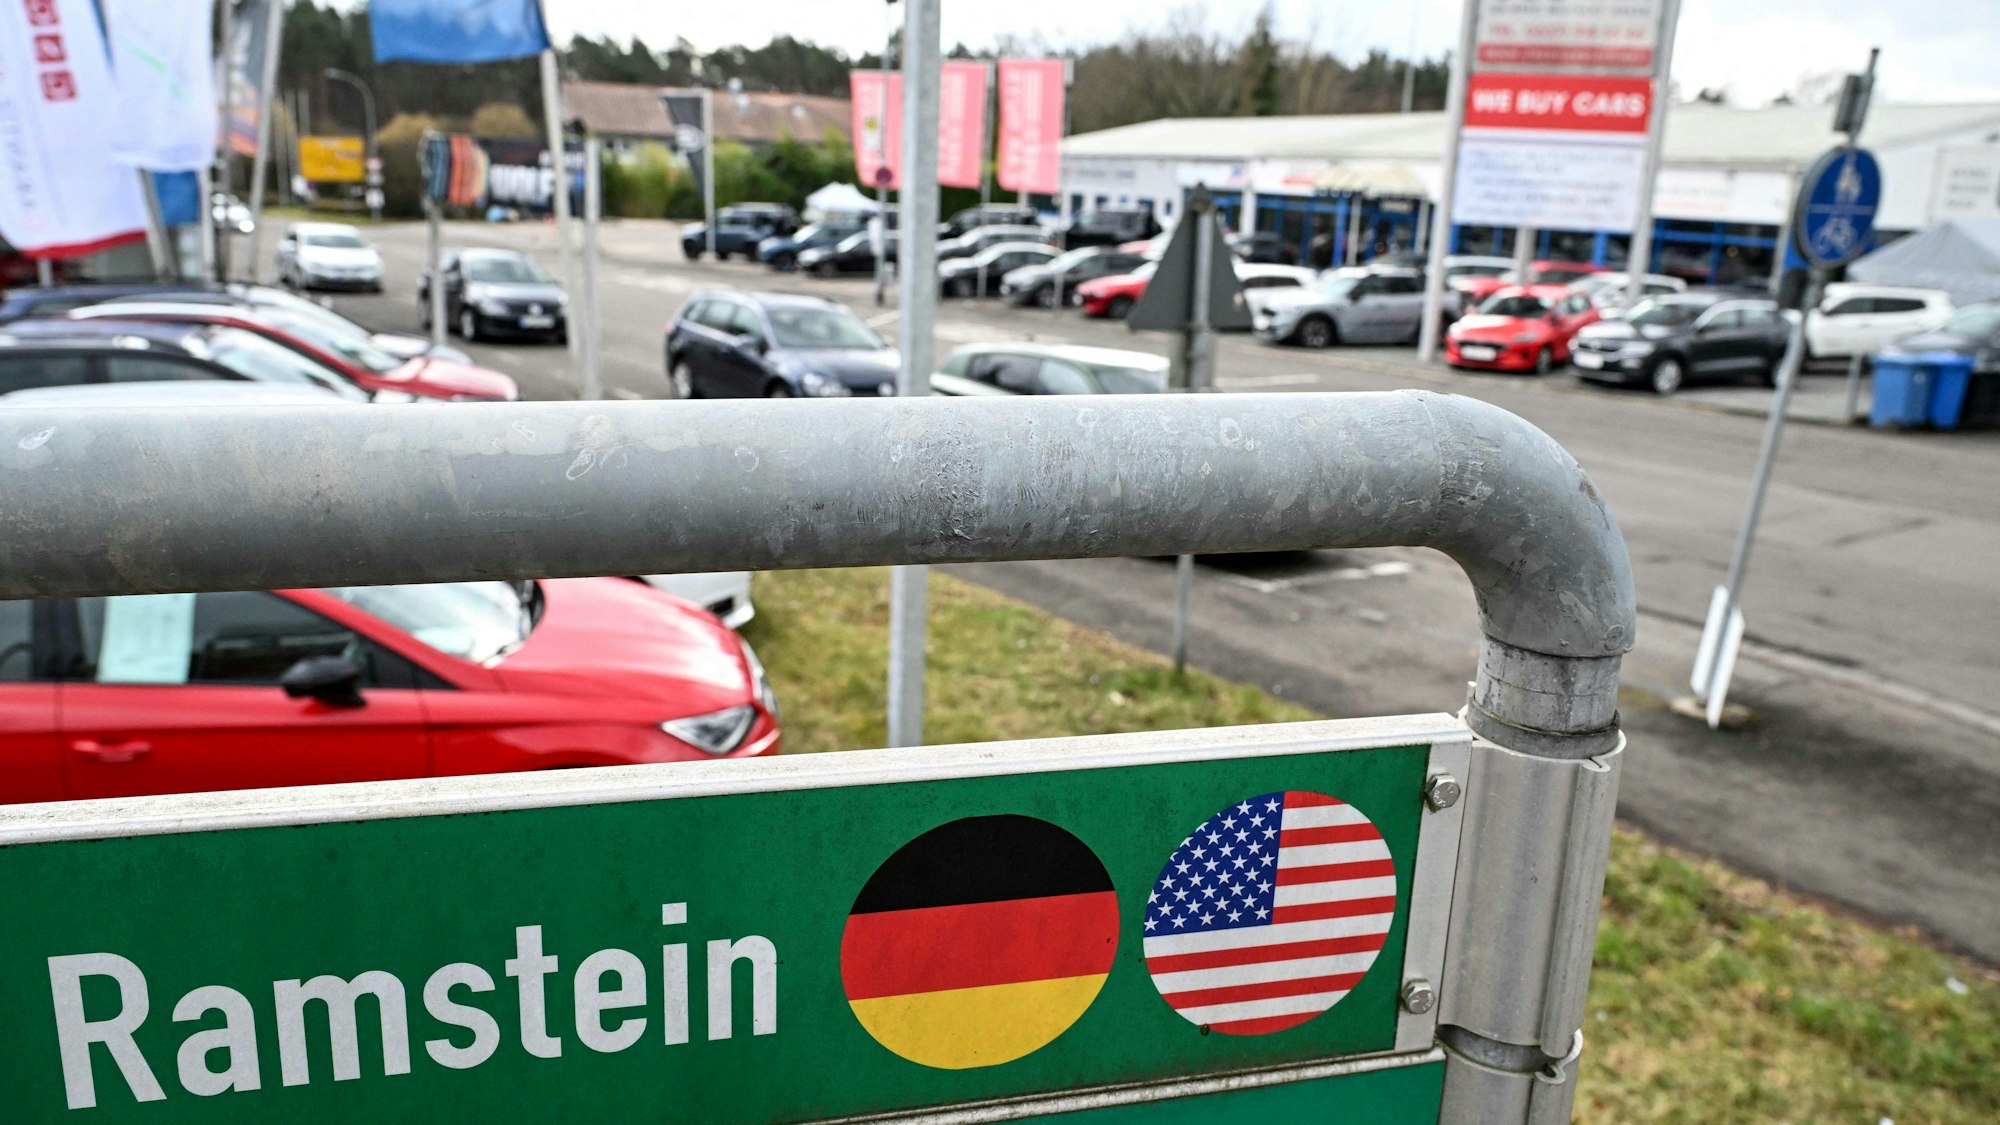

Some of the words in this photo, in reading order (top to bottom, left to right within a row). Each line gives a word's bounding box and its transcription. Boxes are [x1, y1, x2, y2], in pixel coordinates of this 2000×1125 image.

[1473, 88, 1513, 113] WE
[1516, 90, 1569, 115] BUY
[1572, 91, 1646, 117] CARS
[48, 903, 776, 1109] Ramstein
